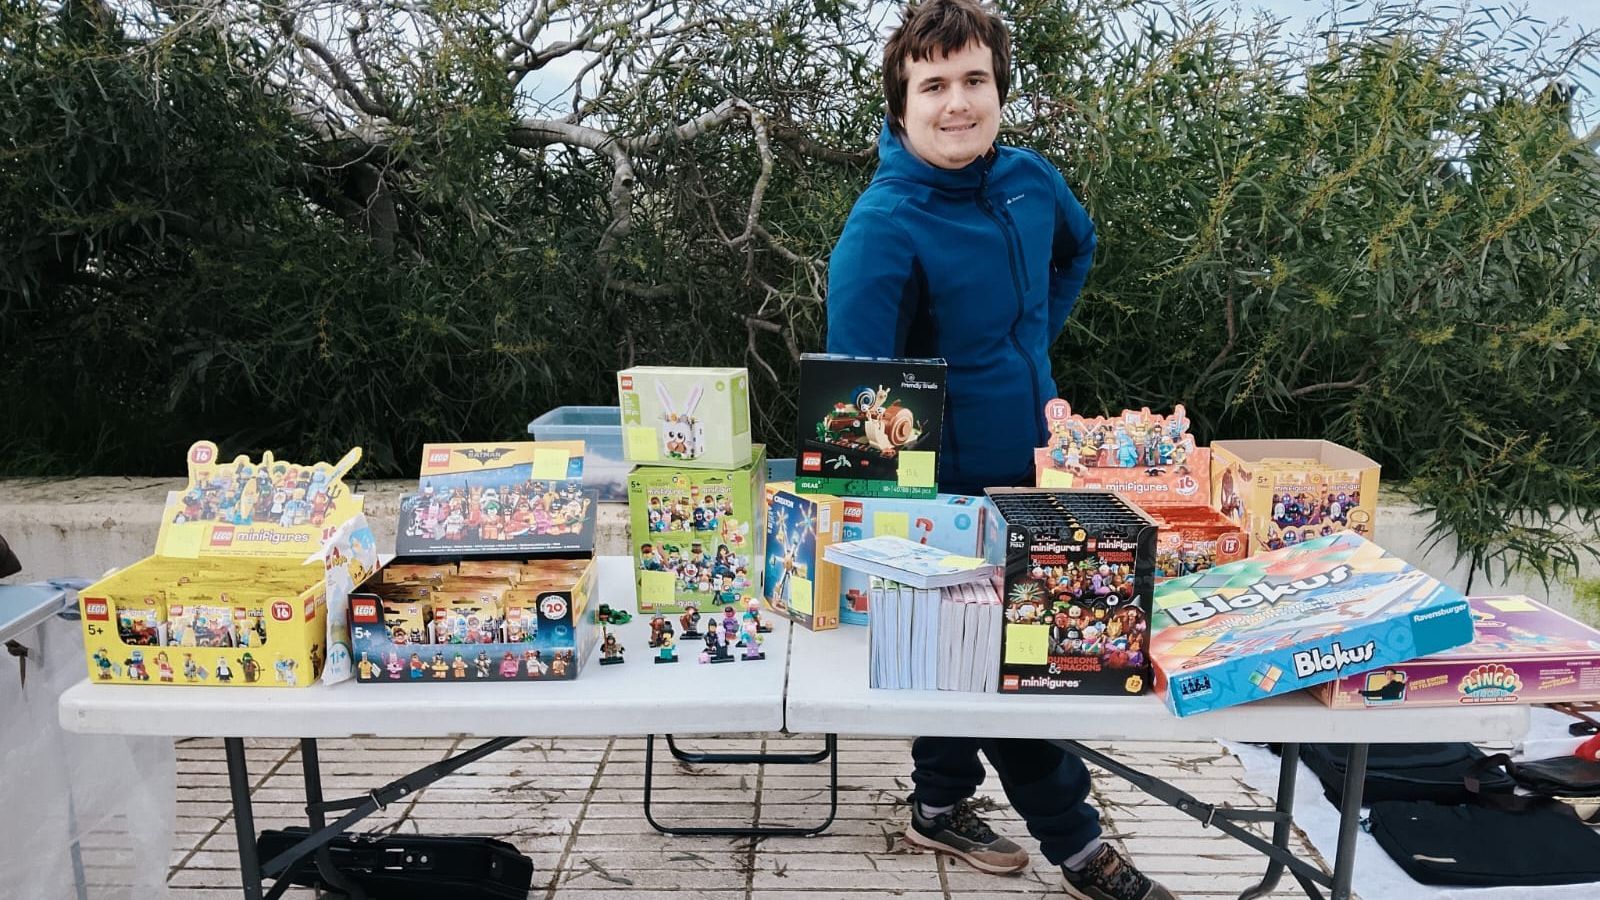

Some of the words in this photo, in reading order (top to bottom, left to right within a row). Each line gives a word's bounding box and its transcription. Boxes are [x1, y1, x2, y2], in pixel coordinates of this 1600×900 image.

[196, 450, 208, 461] 16
[430, 454, 448, 463] LEGO
[468, 450, 501, 459] BATMAN
[804, 458, 821, 466] LEGO
[801, 482, 818, 490] IDEAS
[1180, 476, 1195, 489] 16
[1257, 476, 1267, 484] 5+
[1105, 481, 1169, 494] minifigures
[844, 508, 862, 516] LEGO
[211, 530, 233, 542] LEGO
[236, 528, 310, 545] minifigures
[1010, 532, 1025, 542] 5+
[1030, 542, 1081, 554] minifigures
[1098, 540, 1138, 550] minifigur
[1225, 541, 1236, 552] 15
[1166, 564, 1353, 625] Blokus
[85, 602, 108, 616] LEGO
[275, 608, 289, 619] 16
[354, 605, 376, 616] LEGO
[547, 602, 563, 613] 20
[1412, 602, 1468, 624] Ravensburger
[88, 624, 105, 637] 5+
[354, 627, 371, 640] 5+
[1048, 656, 1099, 665] DUNGEONS
[1293, 639, 1376, 678] Blokus
[1021, 676, 1081, 690] minifigures
[1465, 671, 1516, 689] LINGO
